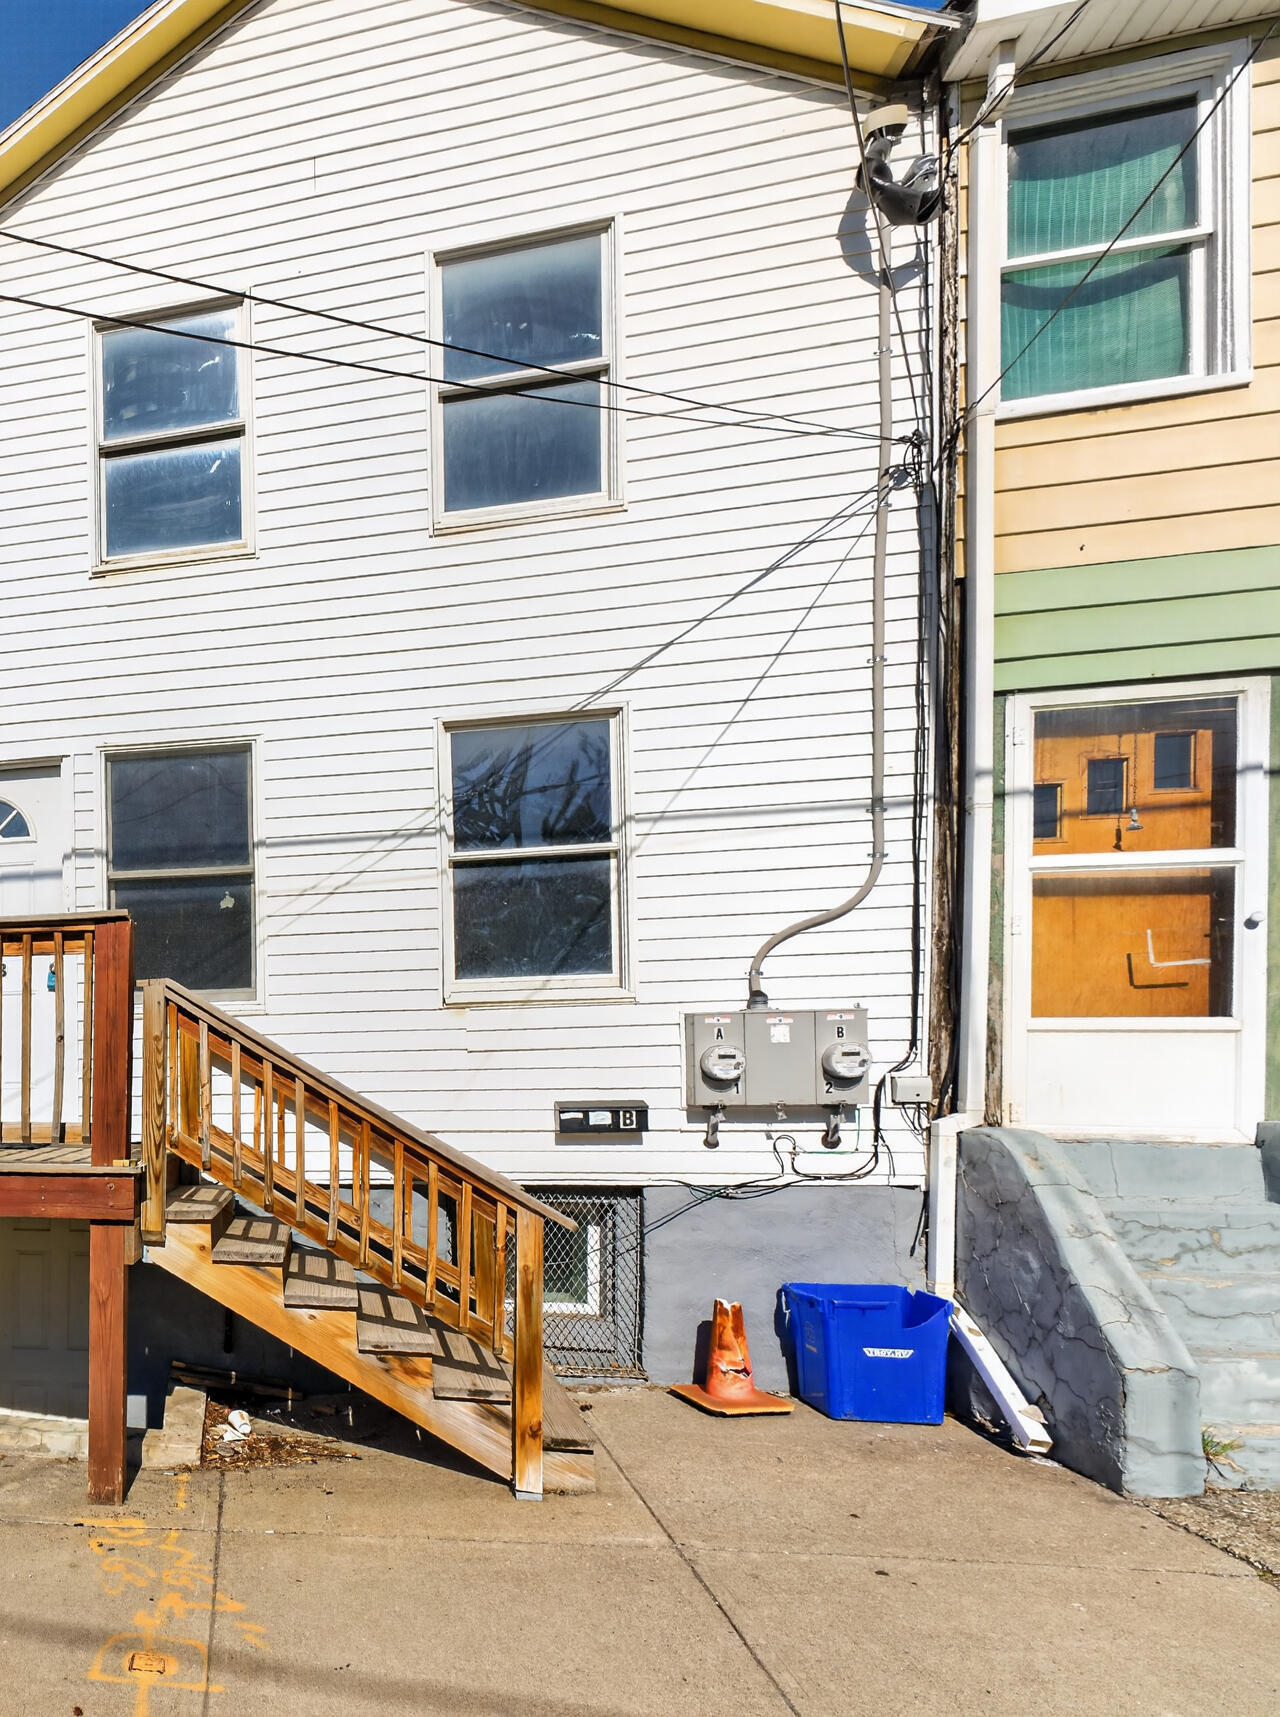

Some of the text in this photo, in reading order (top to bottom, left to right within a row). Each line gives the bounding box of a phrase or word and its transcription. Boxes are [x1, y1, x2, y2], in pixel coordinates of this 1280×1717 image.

[715, 1028, 724, 1040] A
[836, 1026, 845, 1039] B
[733, 1082, 740, 1095] 1
[825, 1082, 833, 1094] 2
[622, 1110, 635, 1127] B
